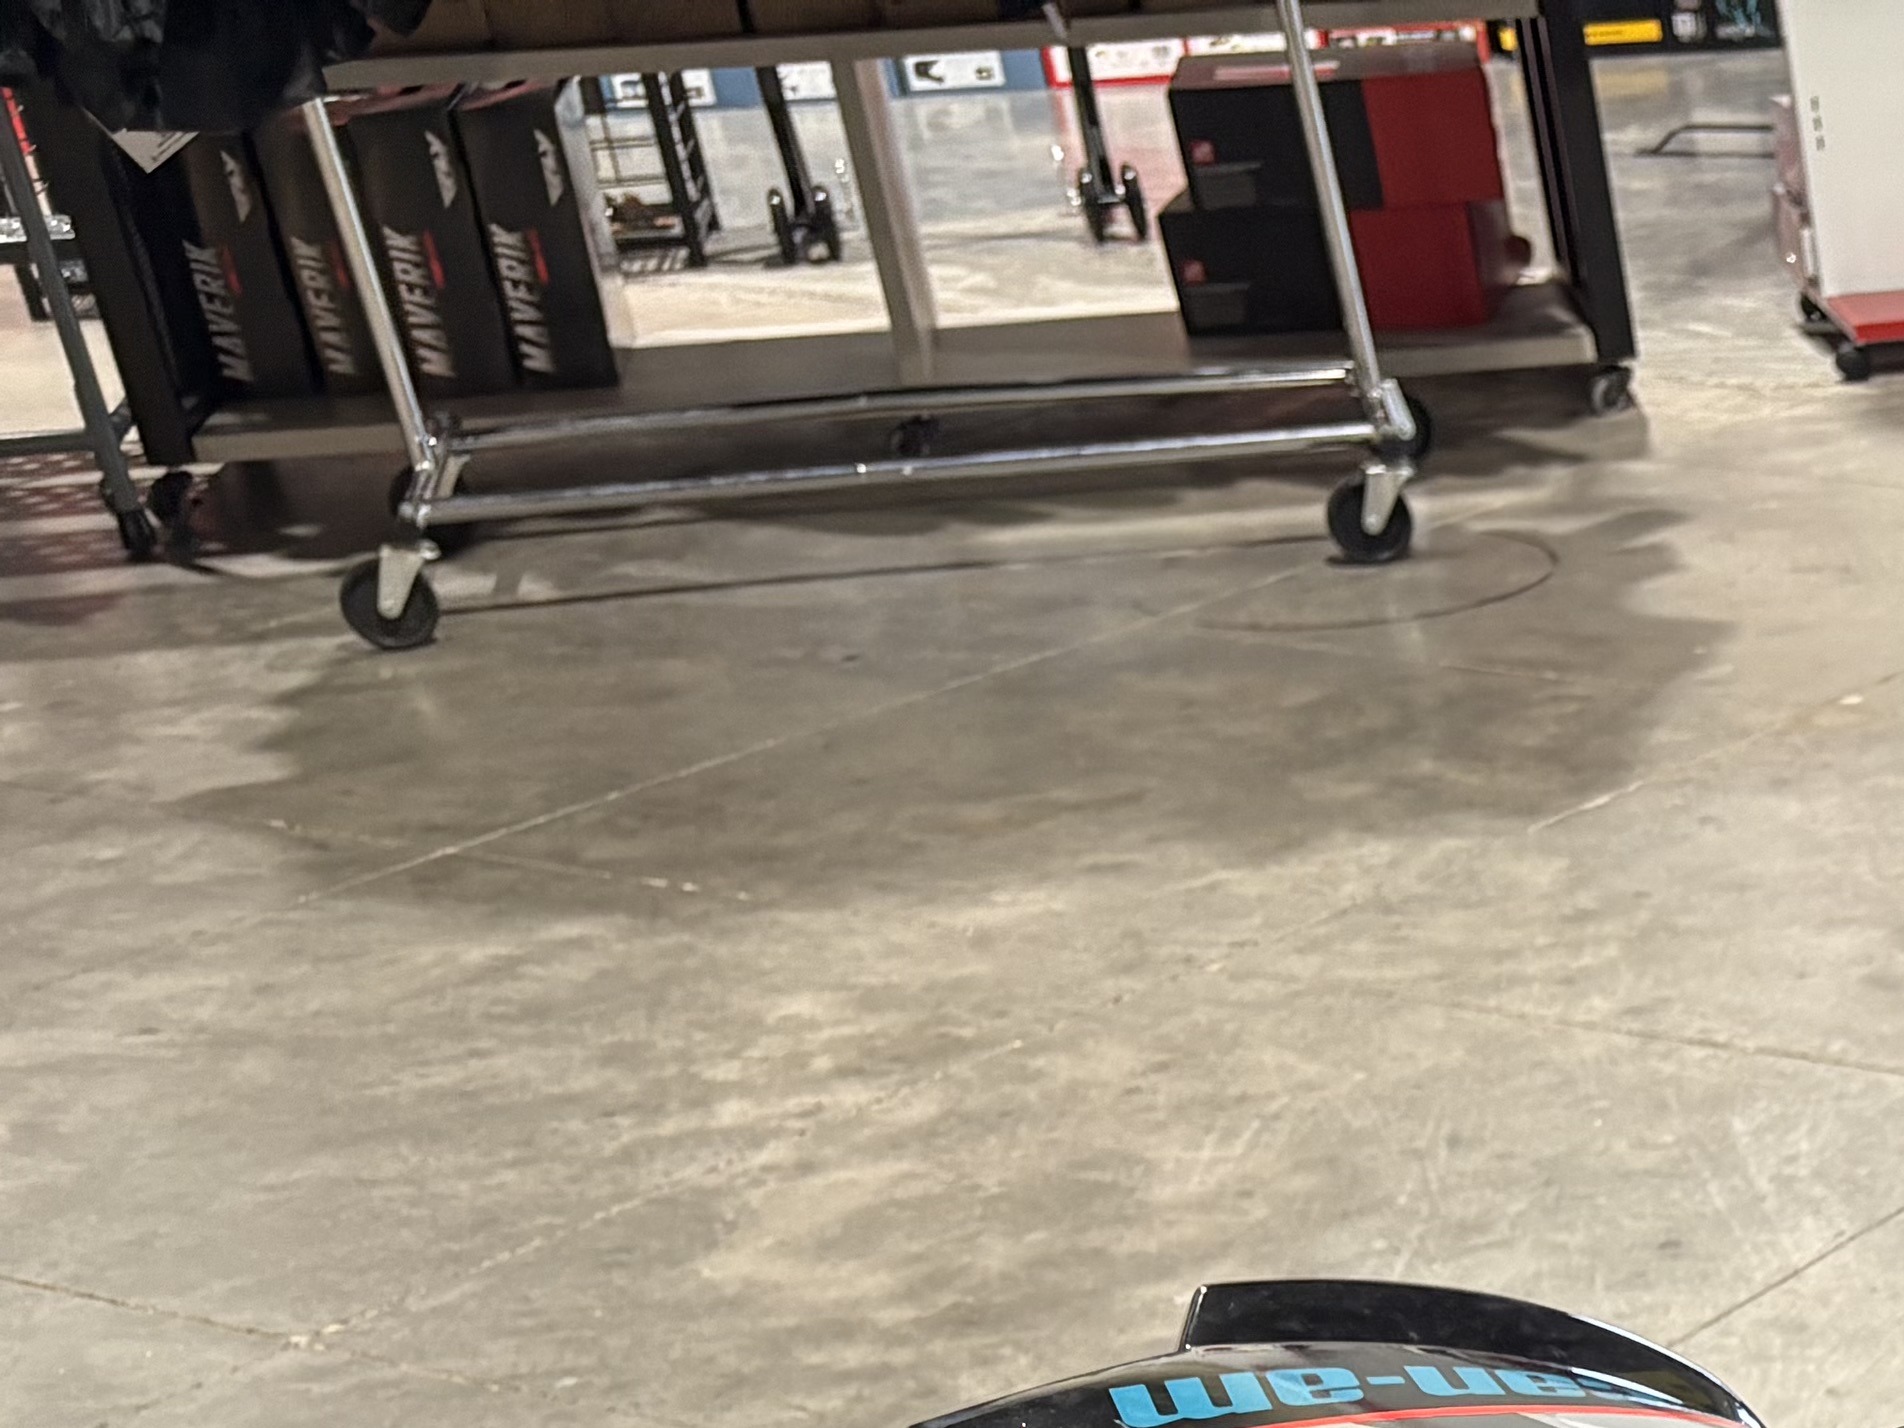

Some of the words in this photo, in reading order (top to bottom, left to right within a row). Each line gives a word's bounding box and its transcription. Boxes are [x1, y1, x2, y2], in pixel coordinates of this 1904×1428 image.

[183, 240, 254, 382] MAVERIK
[381, 224, 455, 377] MAVERIK
[488, 223, 554, 373] MAVERIK
